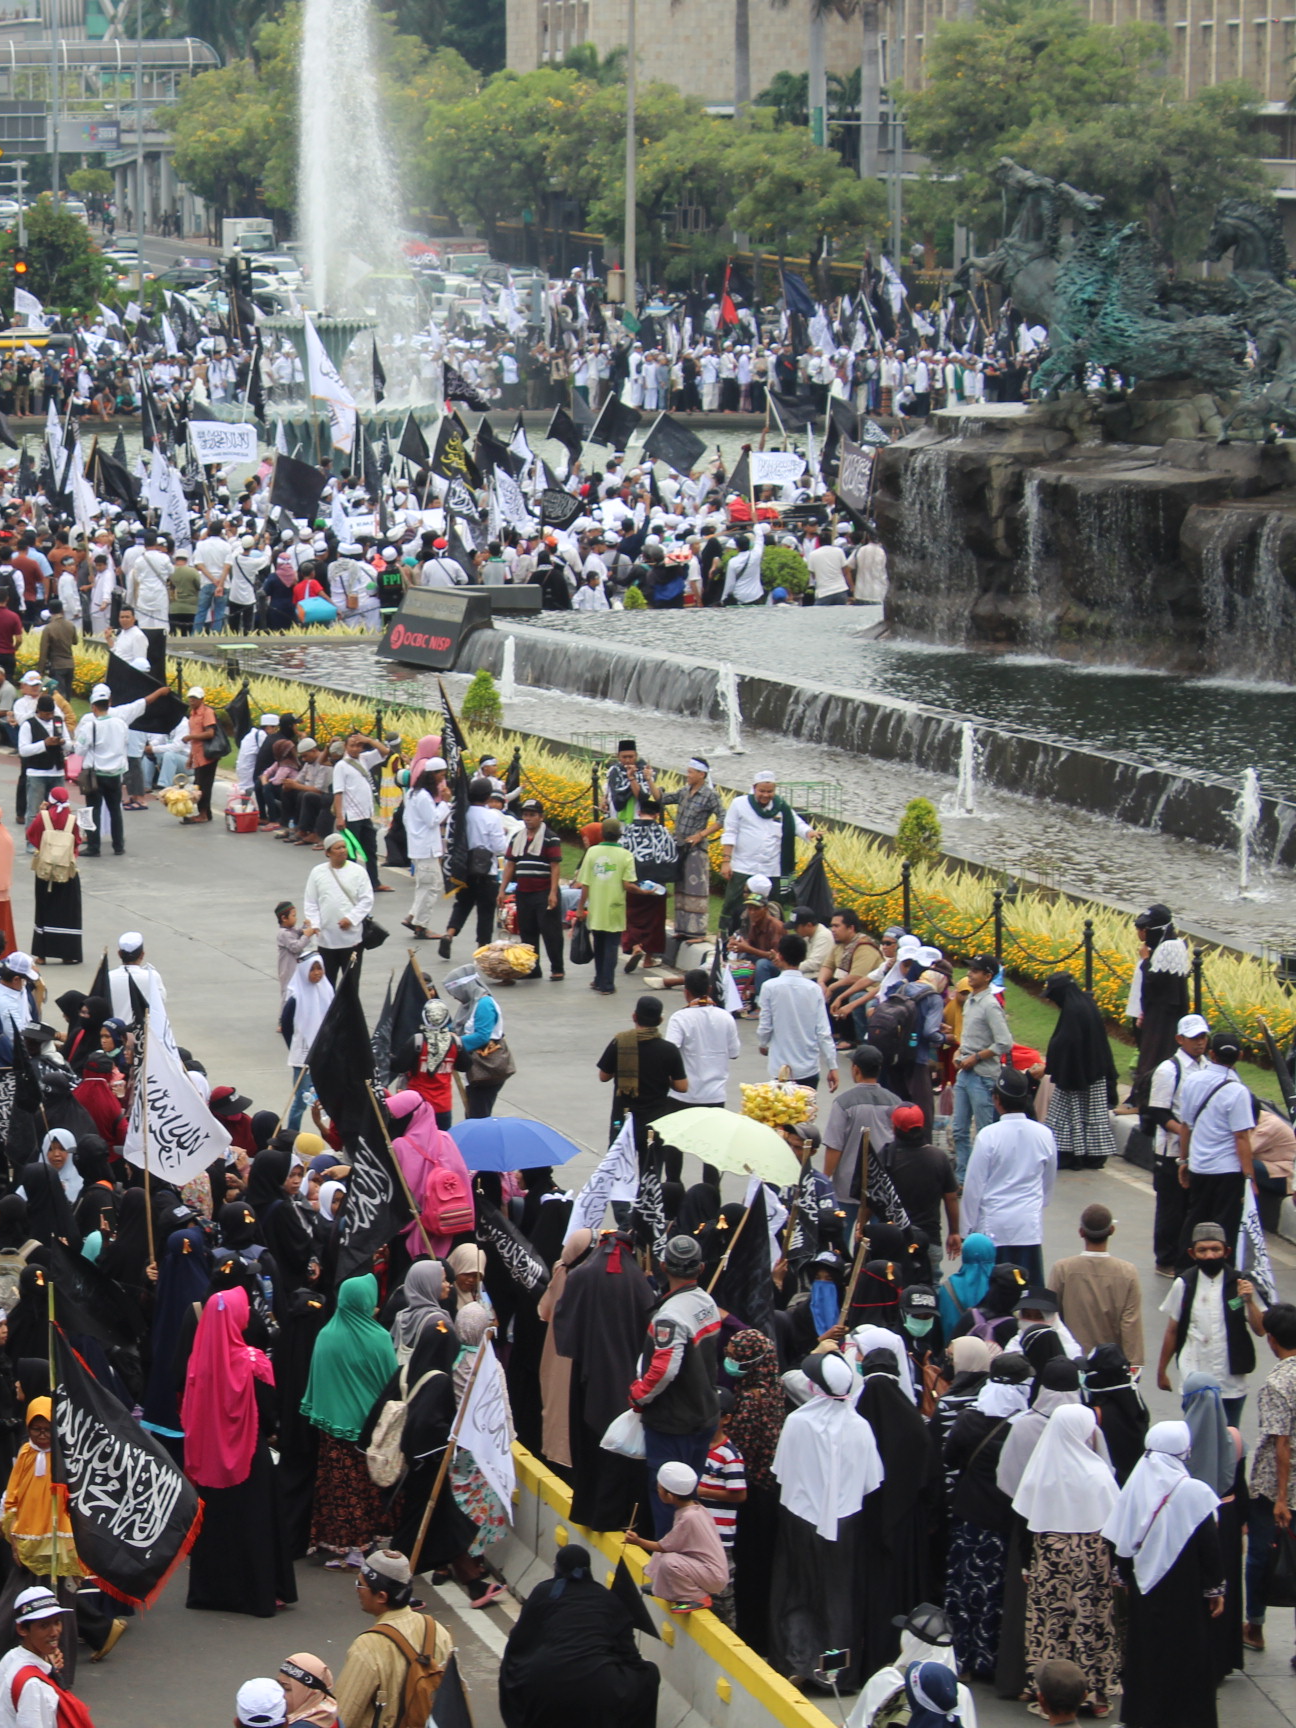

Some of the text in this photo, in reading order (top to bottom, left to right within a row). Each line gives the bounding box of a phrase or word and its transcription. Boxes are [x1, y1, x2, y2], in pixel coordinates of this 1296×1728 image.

[383, 573, 401, 585] FPI
[405, 632, 451, 651] OCBC NISP
